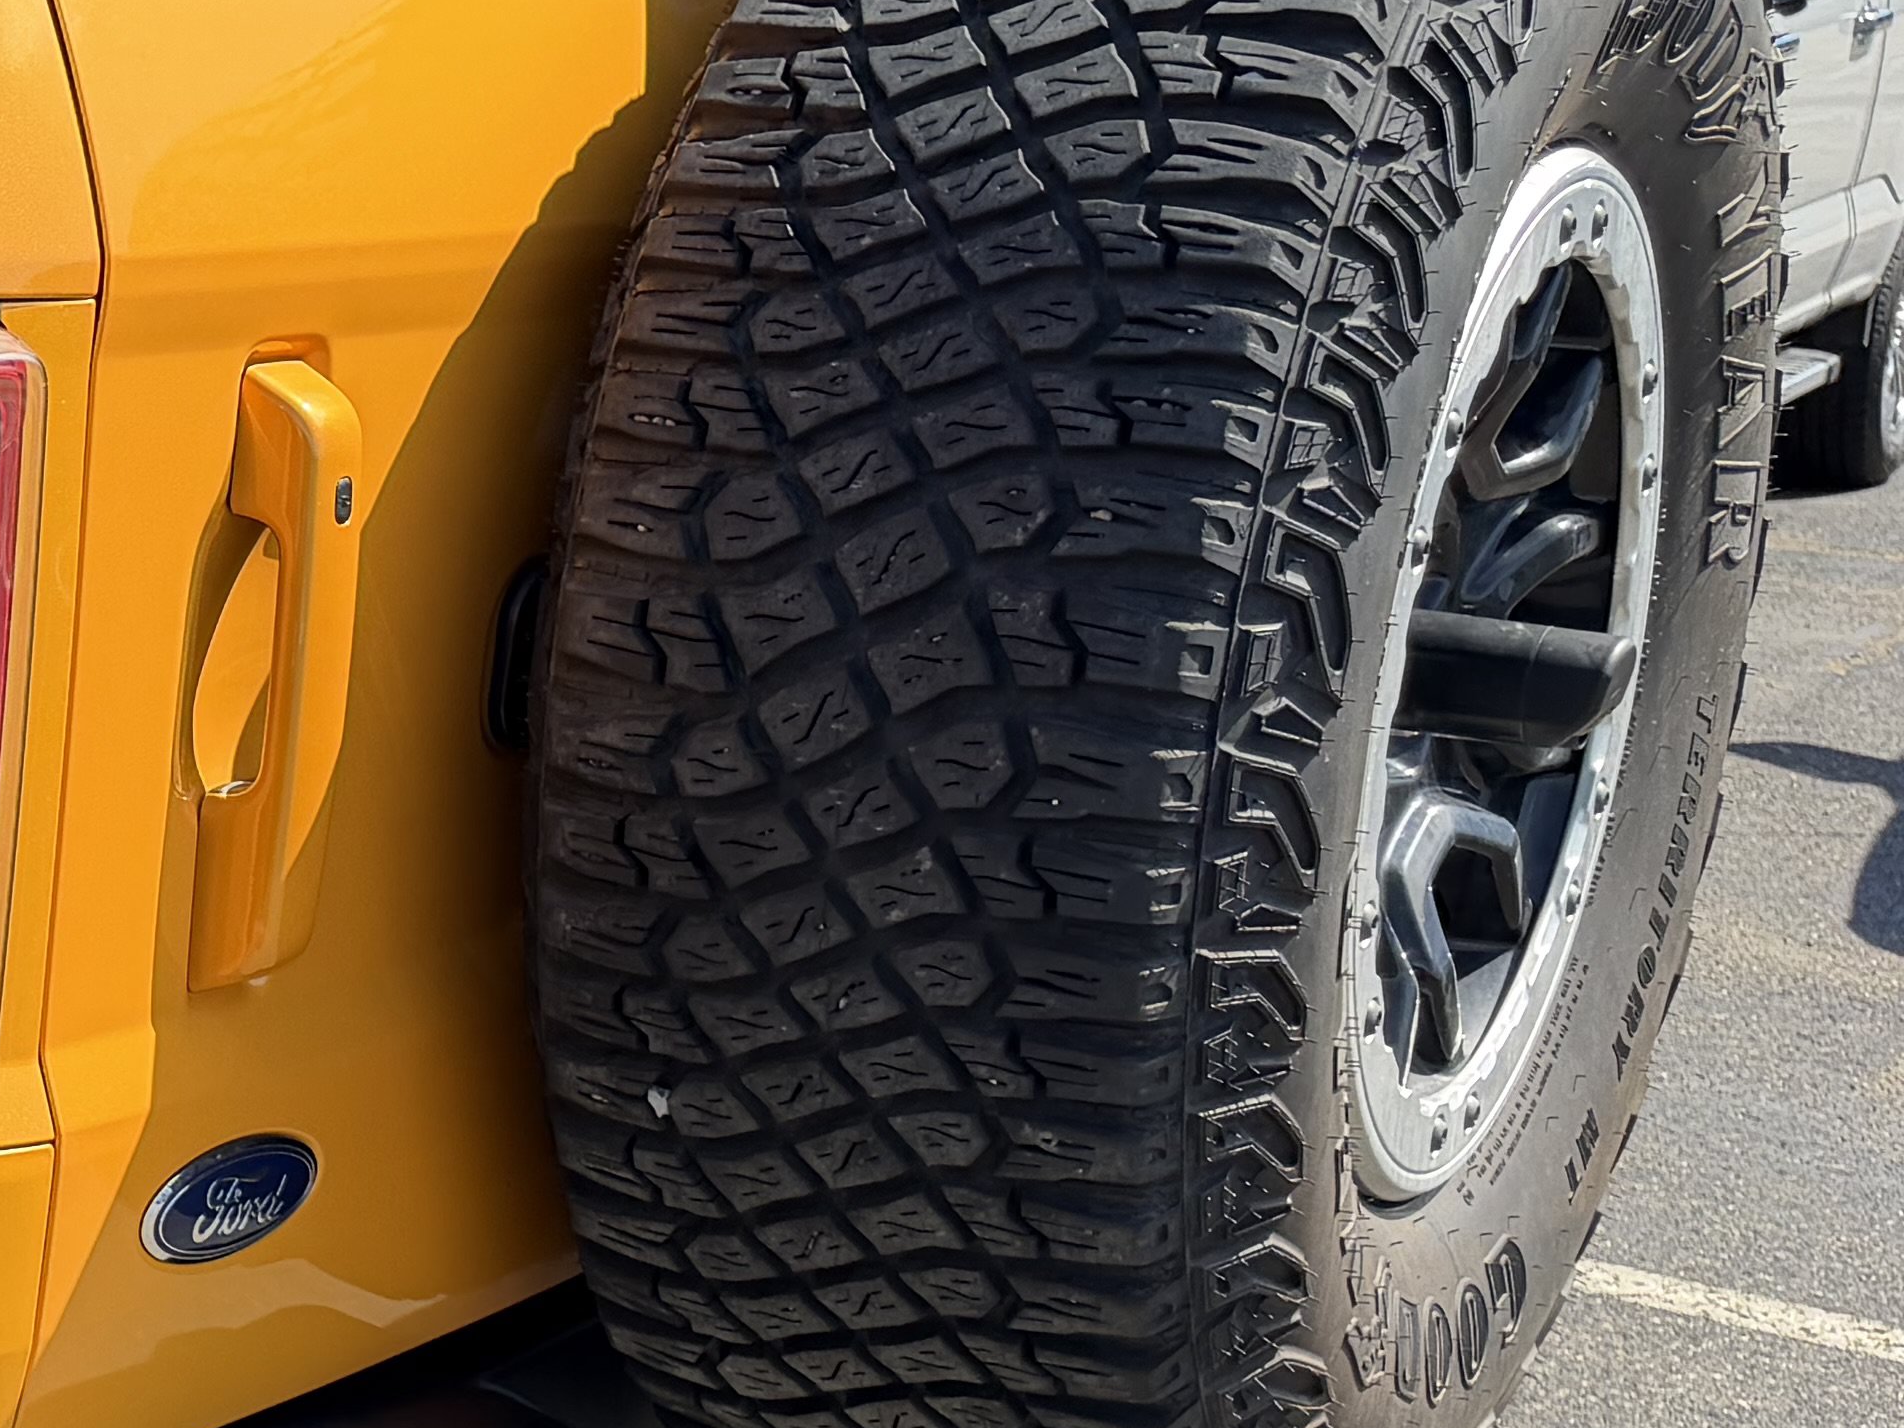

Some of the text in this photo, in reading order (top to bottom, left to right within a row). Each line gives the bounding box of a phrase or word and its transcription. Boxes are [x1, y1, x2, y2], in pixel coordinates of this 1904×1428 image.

[1613, 694, 1719, 1083] TERRITORY
[1563, 1107, 1601, 1205] MT
[192, 1173, 288, 1244] Ford
